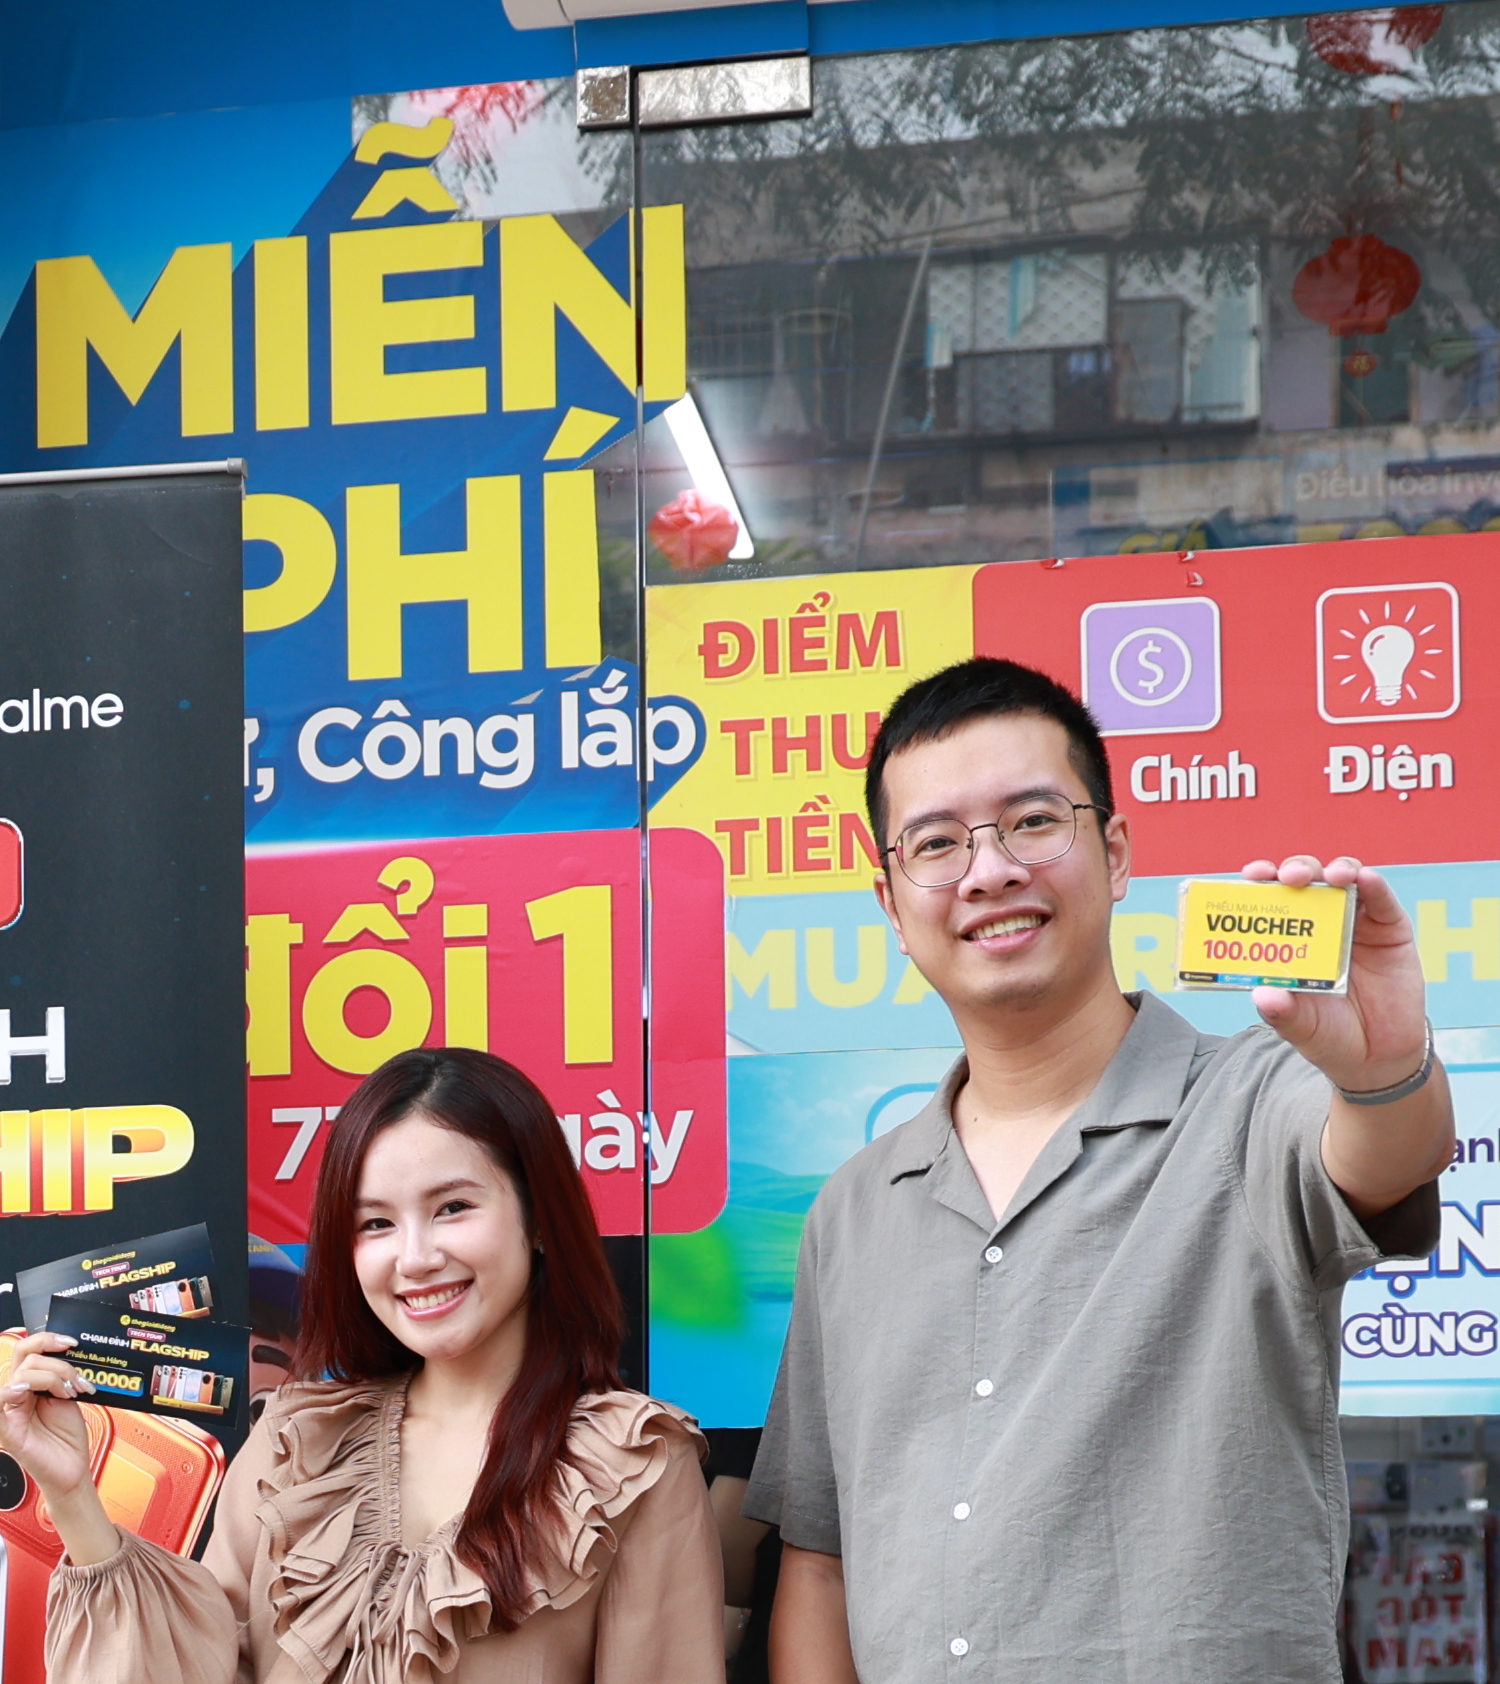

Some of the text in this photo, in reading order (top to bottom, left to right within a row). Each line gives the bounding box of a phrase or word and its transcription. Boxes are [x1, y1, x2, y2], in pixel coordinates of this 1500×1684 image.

[37, 117, 685, 449] MIỄN
[697, 591, 902, 680] ĐIỂM
[298, 699, 537, 791] Công
[560, 668, 697, 783] lắp
[1131, 747, 1257, 804] Chính
[1324, 742, 1454, 802] Điện
[1203, 939, 1308, 964] 100.000đ
[1206, 914, 1314, 938] VOUCHER
[525, 885, 615, 1066] 1
[130, 1339, 210, 1361] FLAGSHIP
[1342, 1302, 1498, 1358] CÙNG
